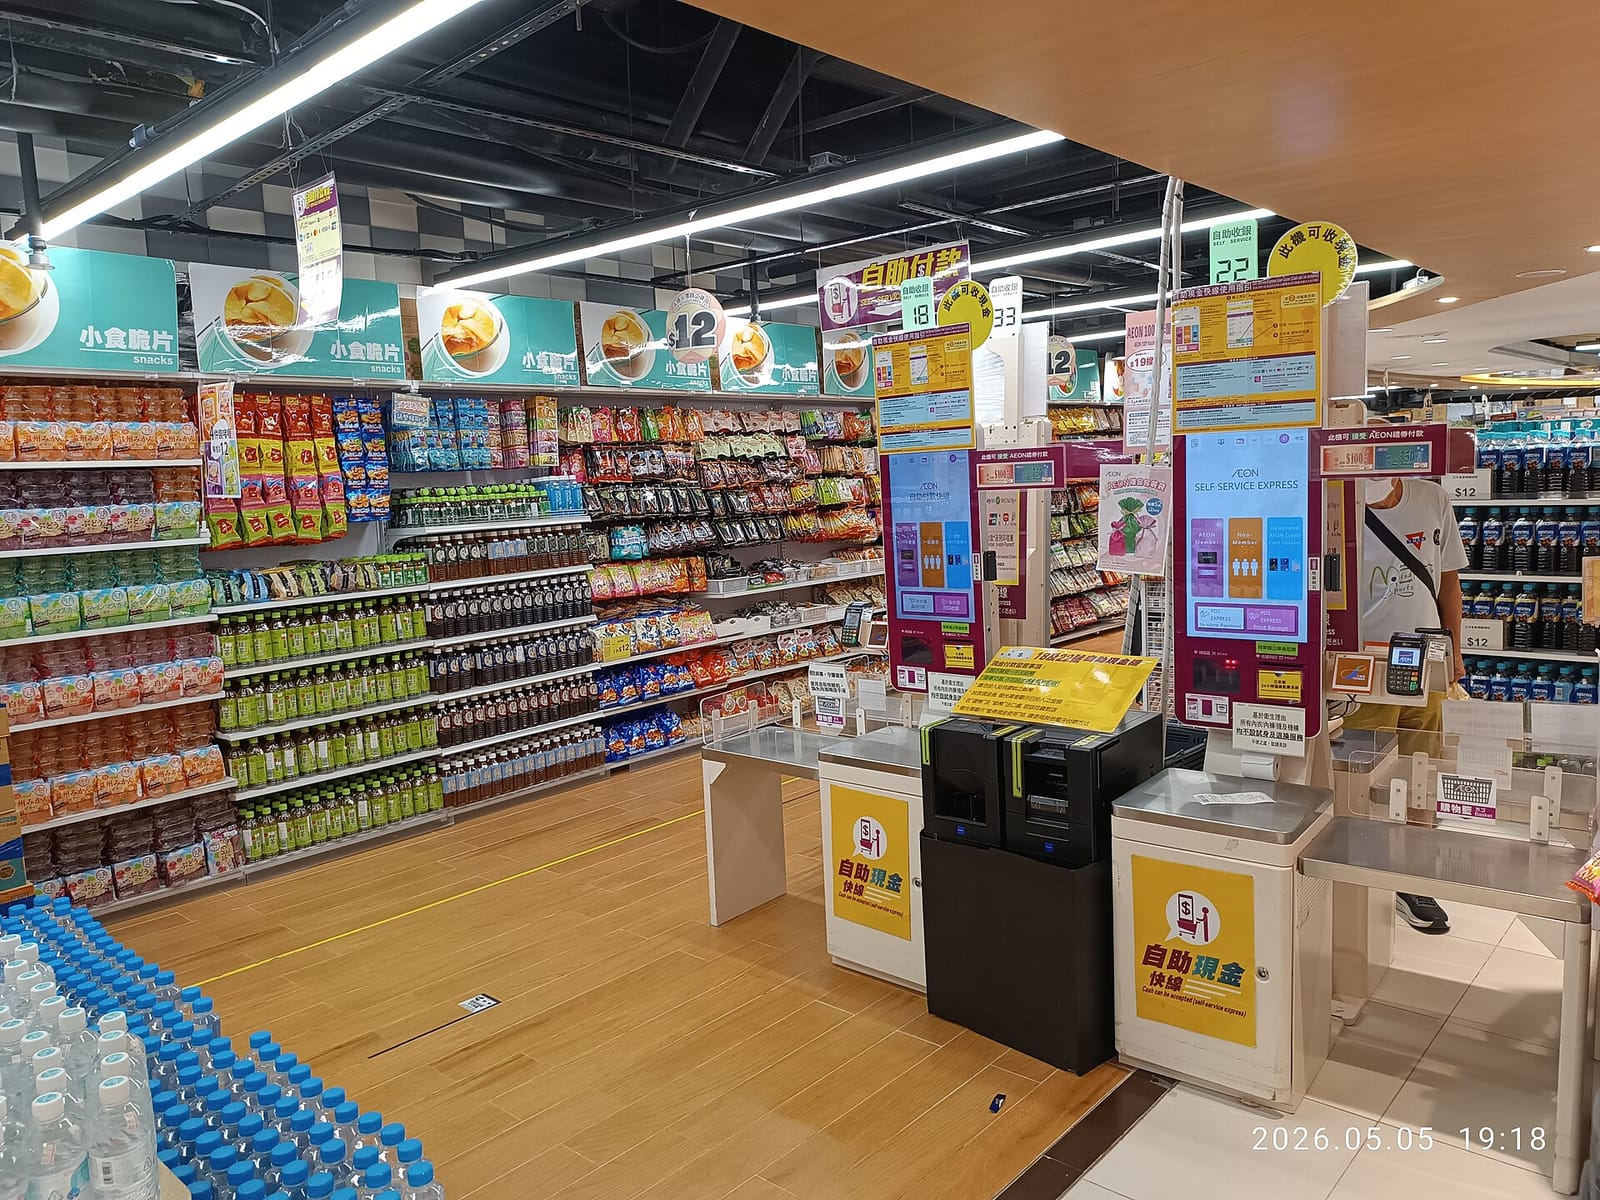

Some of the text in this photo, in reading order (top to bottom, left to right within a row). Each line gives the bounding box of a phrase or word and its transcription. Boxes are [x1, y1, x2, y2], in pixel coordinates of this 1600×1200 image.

[1212, 226, 1252, 240] 自助收銀
[1230, 236, 1252, 244] SERVICE
[861, 248, 962, 291] 自助付款
[1216, 258, 1249, 283] 22
[903, 283, 929, 296] 自助收銀
[914, 304, 929, 325] 18
[80, 325, 174, 352] 小食脆片
[1127, 326, 1144, 339] AEON
[330, 341, 400, 362] 小食脆片
[133, 355, 174, 365] snacks
[522, 349, 577, 371] 小食脆片
[370, 364, 402, 374] snacks
[1328, 432, 1350, 441] 此機可
[1195, 479, 1299, 492] SELF SERVICE EXPRESS
[1455, 487, 1476, 497] $12
[1467, 637, 1488, 648] $12
[1440, 802, 1473, 816] 購物籃
[838, 859, 904, 894] 自助現金
[843, 879, 865, 897] 快線
[1142, 944, 1245, 987] 自助現金
[1149, 971, 1184, 992] 快線
[1142, 985, 1247, 1018] Cash can be accepted (self-service express)
